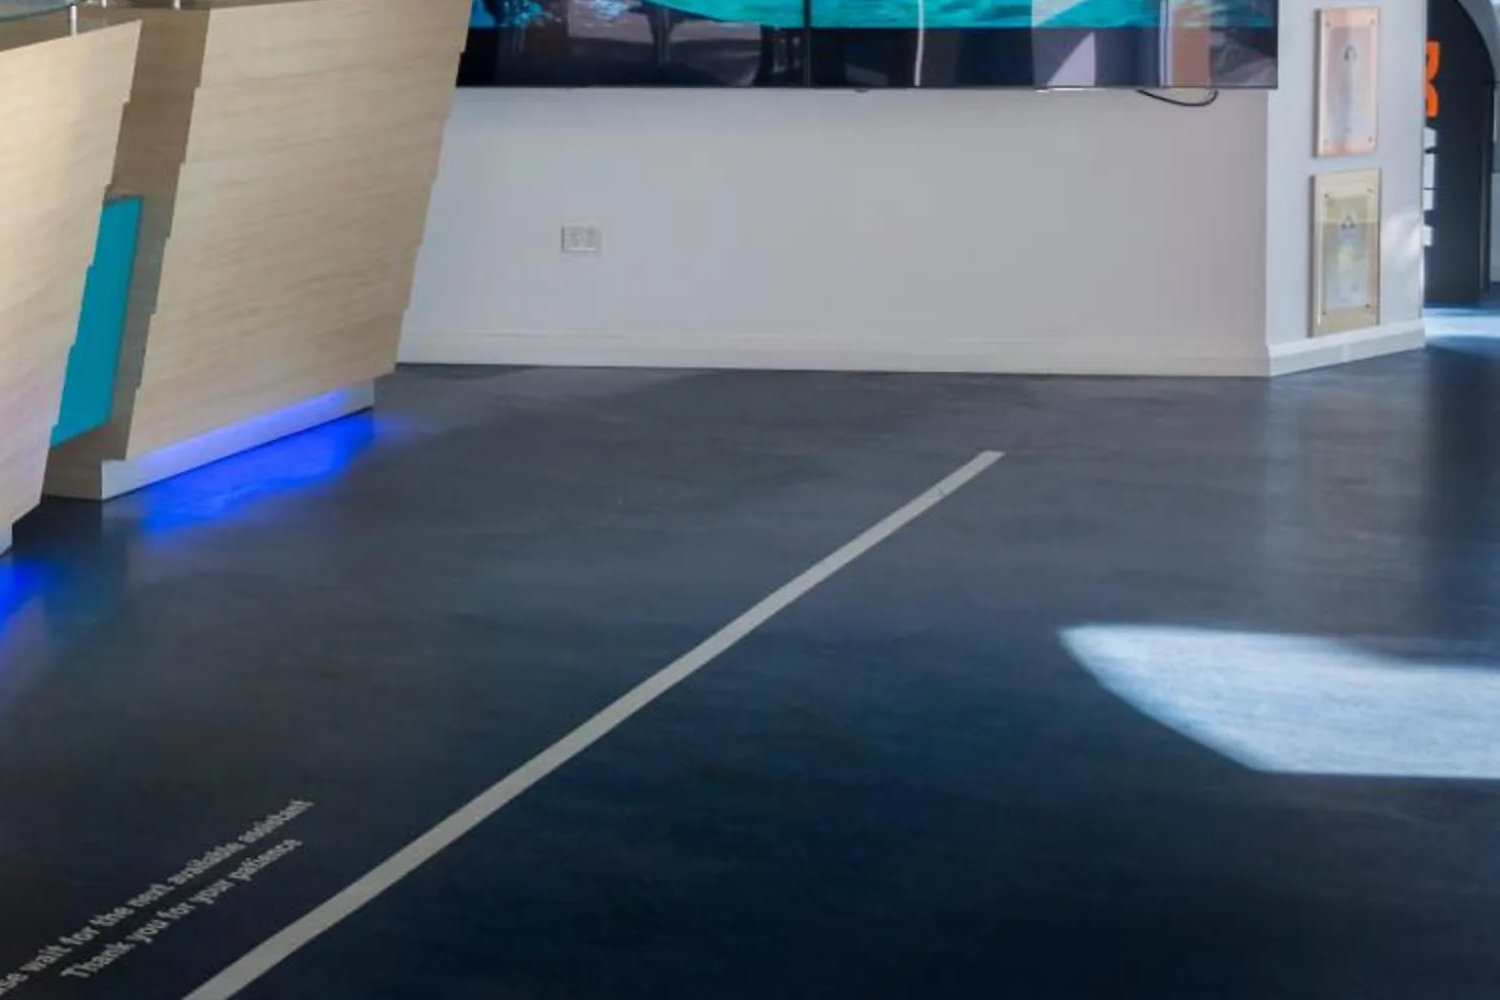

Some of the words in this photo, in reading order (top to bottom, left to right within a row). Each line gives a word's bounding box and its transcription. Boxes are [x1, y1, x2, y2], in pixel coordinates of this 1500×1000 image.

[19, 945, 73, 972] wait
[58, 925, 100, 946] for
[89, 906, 135, 927] the
[126, 883, 176, 907] next
[60, 941, 136, 978] Thank
[125, 919, 171, 944] you
[156, 902, 197, 920] for
[188, 879, 237, 904] your
